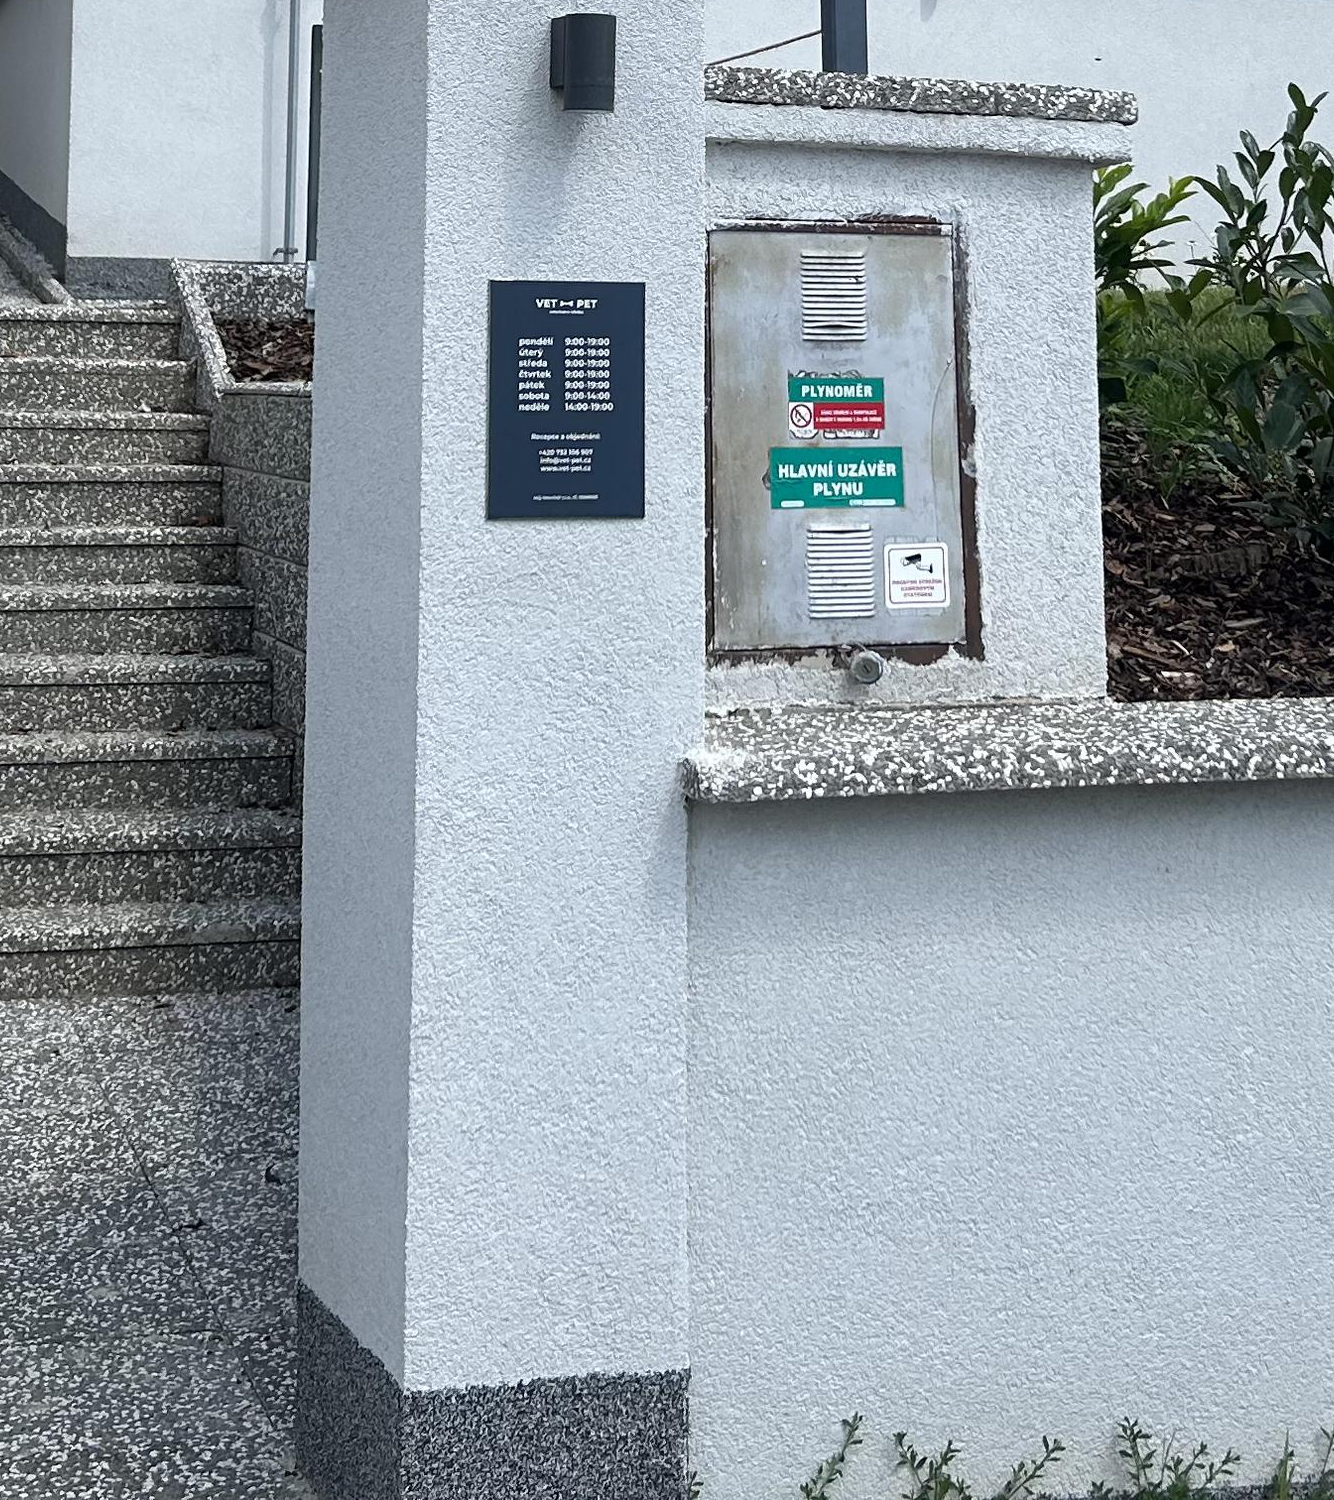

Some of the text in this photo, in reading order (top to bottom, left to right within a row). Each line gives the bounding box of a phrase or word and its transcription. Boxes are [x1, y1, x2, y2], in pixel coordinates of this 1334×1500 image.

[535, 298, 598, 309] VET PET
[518, 337, 554, 347] pondělí
[518, 348, 543, 358] úterý
[518, 358, 548, 367] středa
[518, 370, 552, 379] čtvrtek
[518, 380, 545, 390] pátek
[801, 382, 873, 398] PLYNOMĚR
[518, 391, 550, 400] sobota
[518, 402, 550, 411] neděle
[778, 459, 897, 478] HLAVNÍ UZÁVĚR
[813, 481, 864, 496] PLYNU
